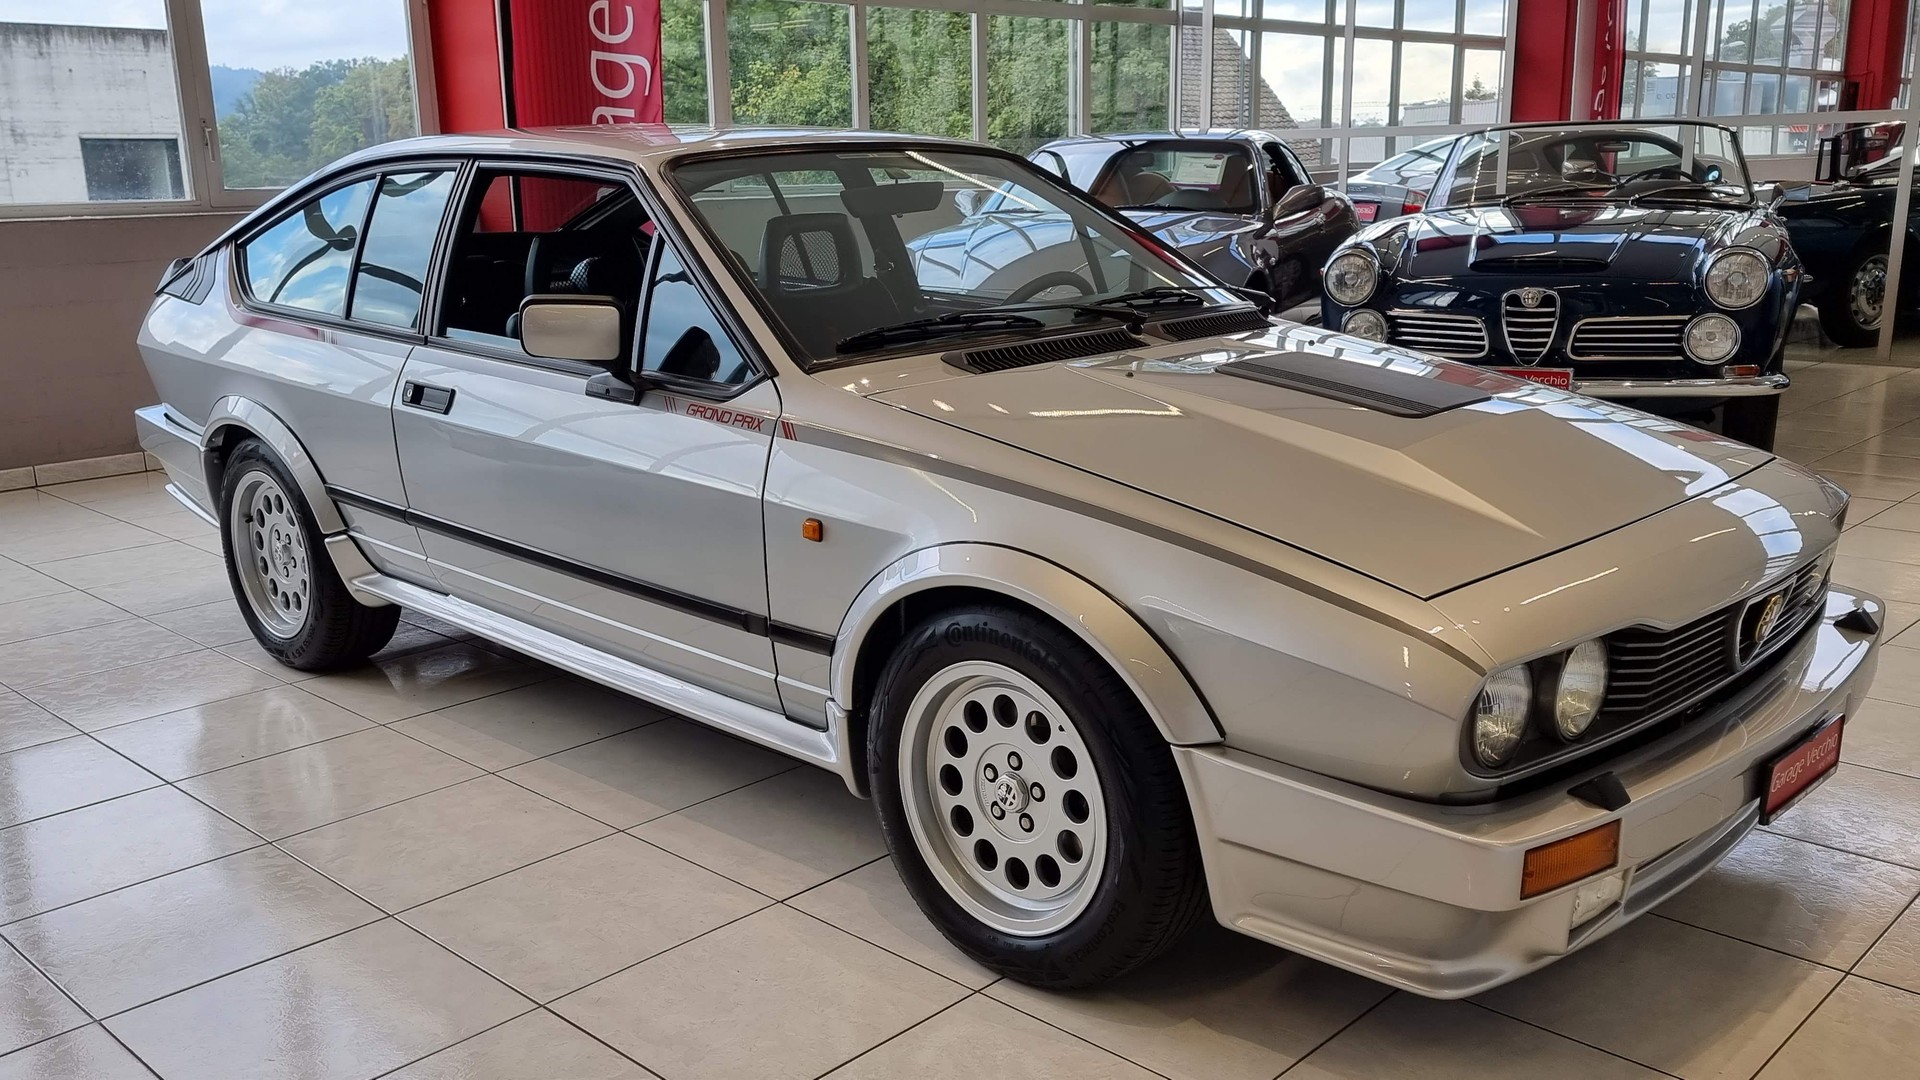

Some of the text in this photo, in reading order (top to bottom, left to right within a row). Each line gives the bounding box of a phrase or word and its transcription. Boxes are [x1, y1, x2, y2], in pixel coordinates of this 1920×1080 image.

[733, 414, 765, 431] PRIX
[944, 620, 1050, 668] Continental
[1771, 759, 1804, 792] Garage
[1807, 734, 1838, 766] Vecchio
